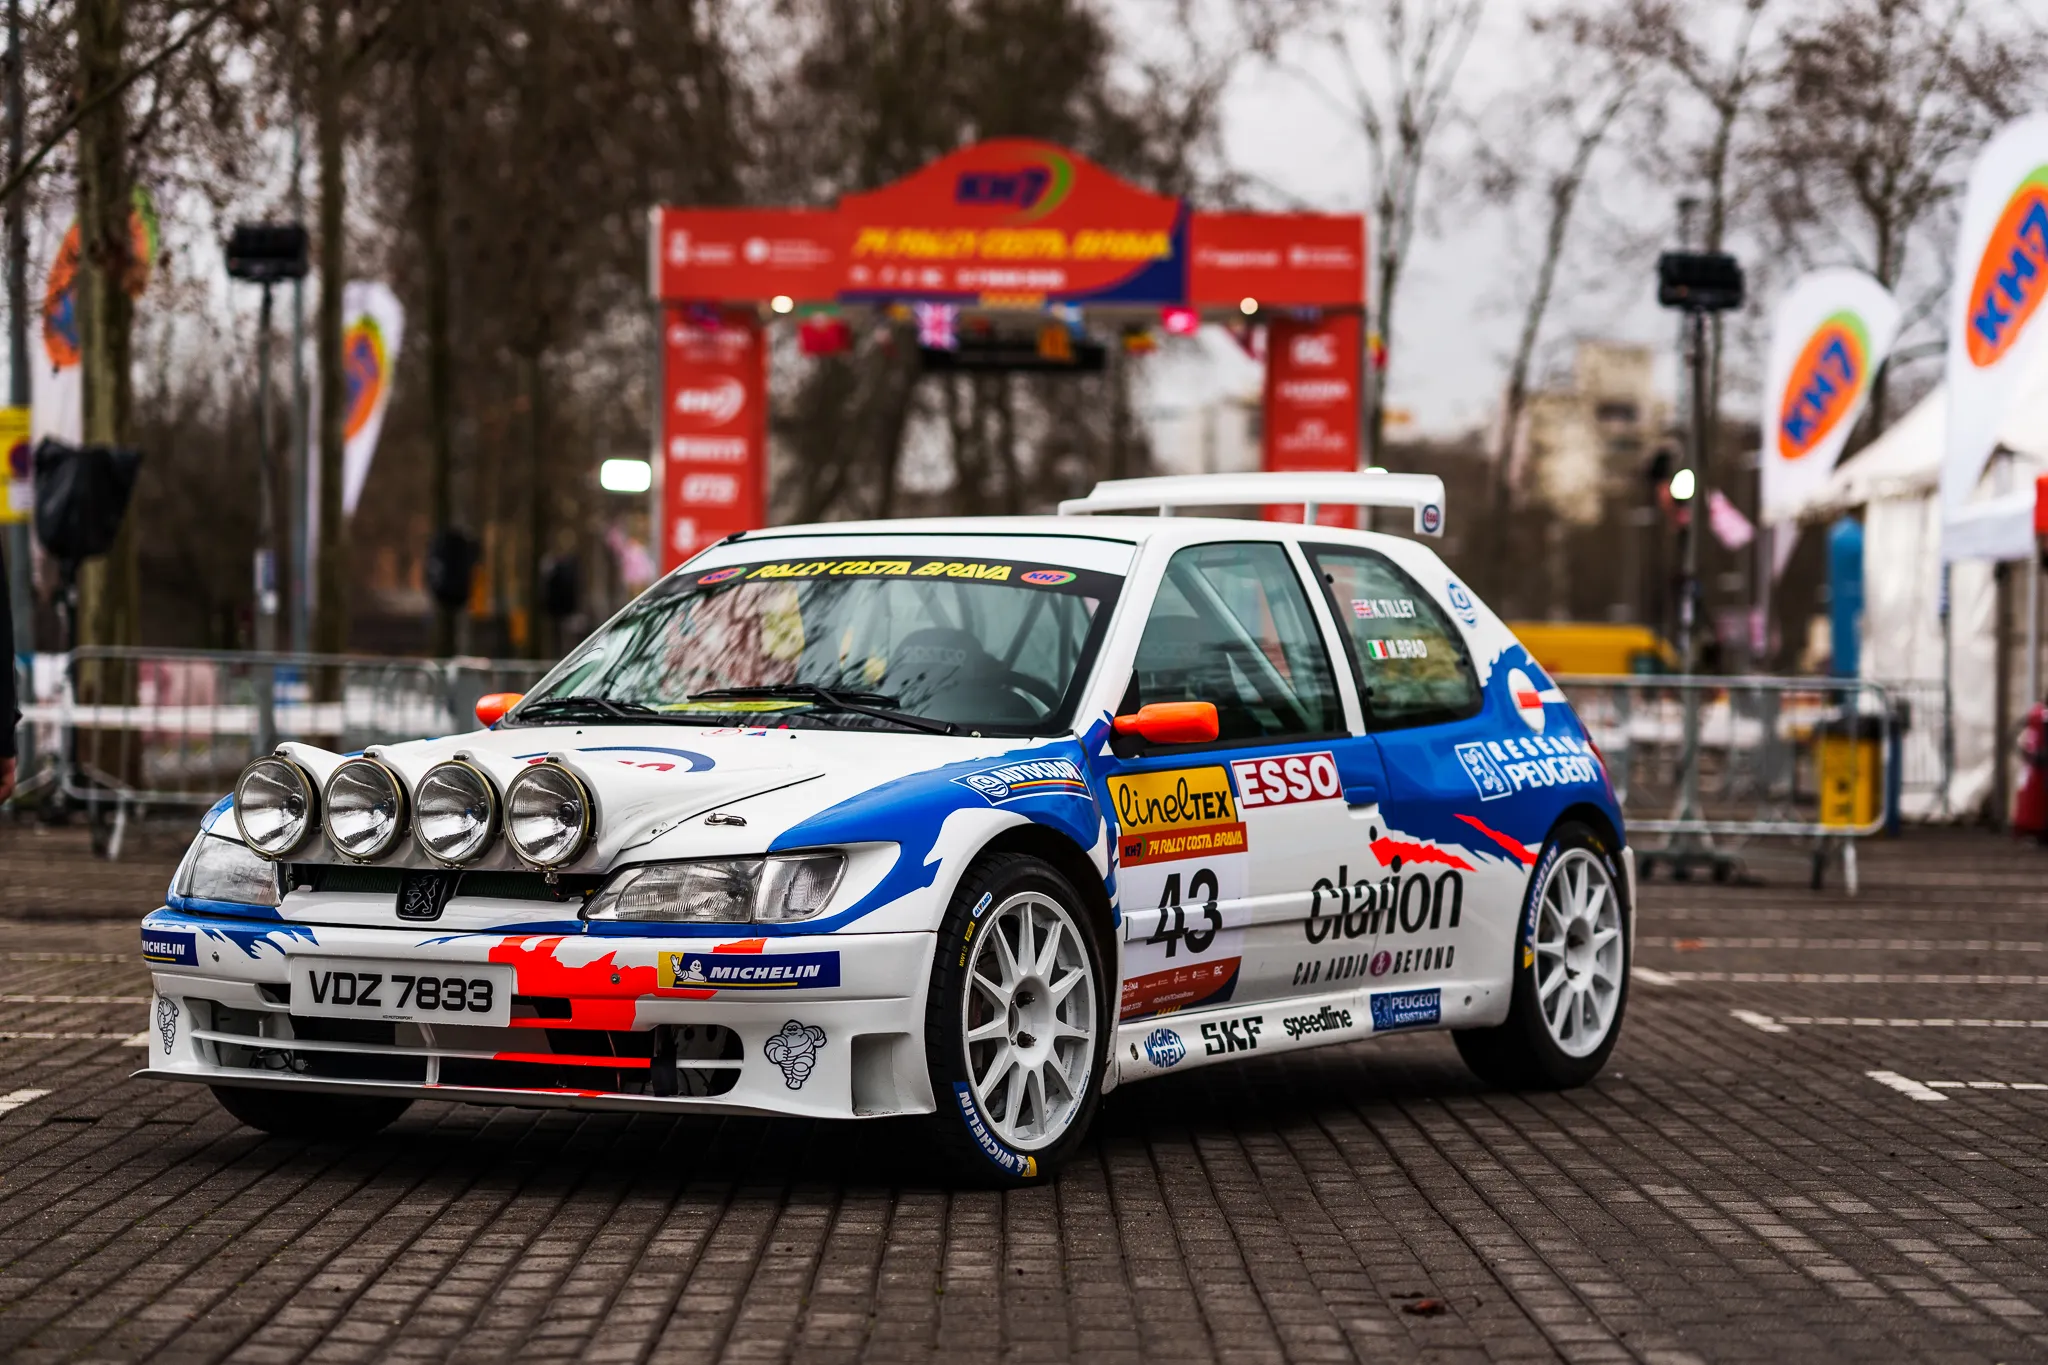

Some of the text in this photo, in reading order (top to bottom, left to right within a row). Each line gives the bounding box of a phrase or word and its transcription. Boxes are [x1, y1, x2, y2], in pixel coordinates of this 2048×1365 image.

[745, 561, 837, 580] RALLY
[828, 560, 912, 576] COSTA
[911, 561, 1013, 581] BRAVA
[1486, 736, 1582, 762] RESEAU
[990, 761, 1083, 784] AUTOCOLOR
[1233, 755, 1340, 806] ESSO
[1503, 754, 1598, 791] PEUGEOT
[1148, 840, 1160, 856] 74
[1160, 836, 1187, 854] RALLY
[1186, 833, 1212, 851] COSTA
[1213, 830, 1244, 848] BRAVA
[1304, 854, 1464, 945] clarion
[1529, 844, 1558, 929] MICHELIN
[1146, 868, 1223, 958] 43
[141, 939, 186, 956] MICHELIN
[1292, 960, 1322, 986] CAR
[1325, 953, 1369, 982] AUDIO
[1392, 945, 1455, 975] BEYOND
[709, 964, 821, 980] MICHELIN
[308, 970, 494, 1013] VDZ 7833
[1392, 993, 1439, 1010] PEUGEOT
[1282, 1005, 1353, 1041] speedline
[1395, 1009, 1438, 1023] ASSISTANCE
[1200, 1016, 1264, 1056] SKF
[958, 1091, 1015, 1169] MICHELIN
